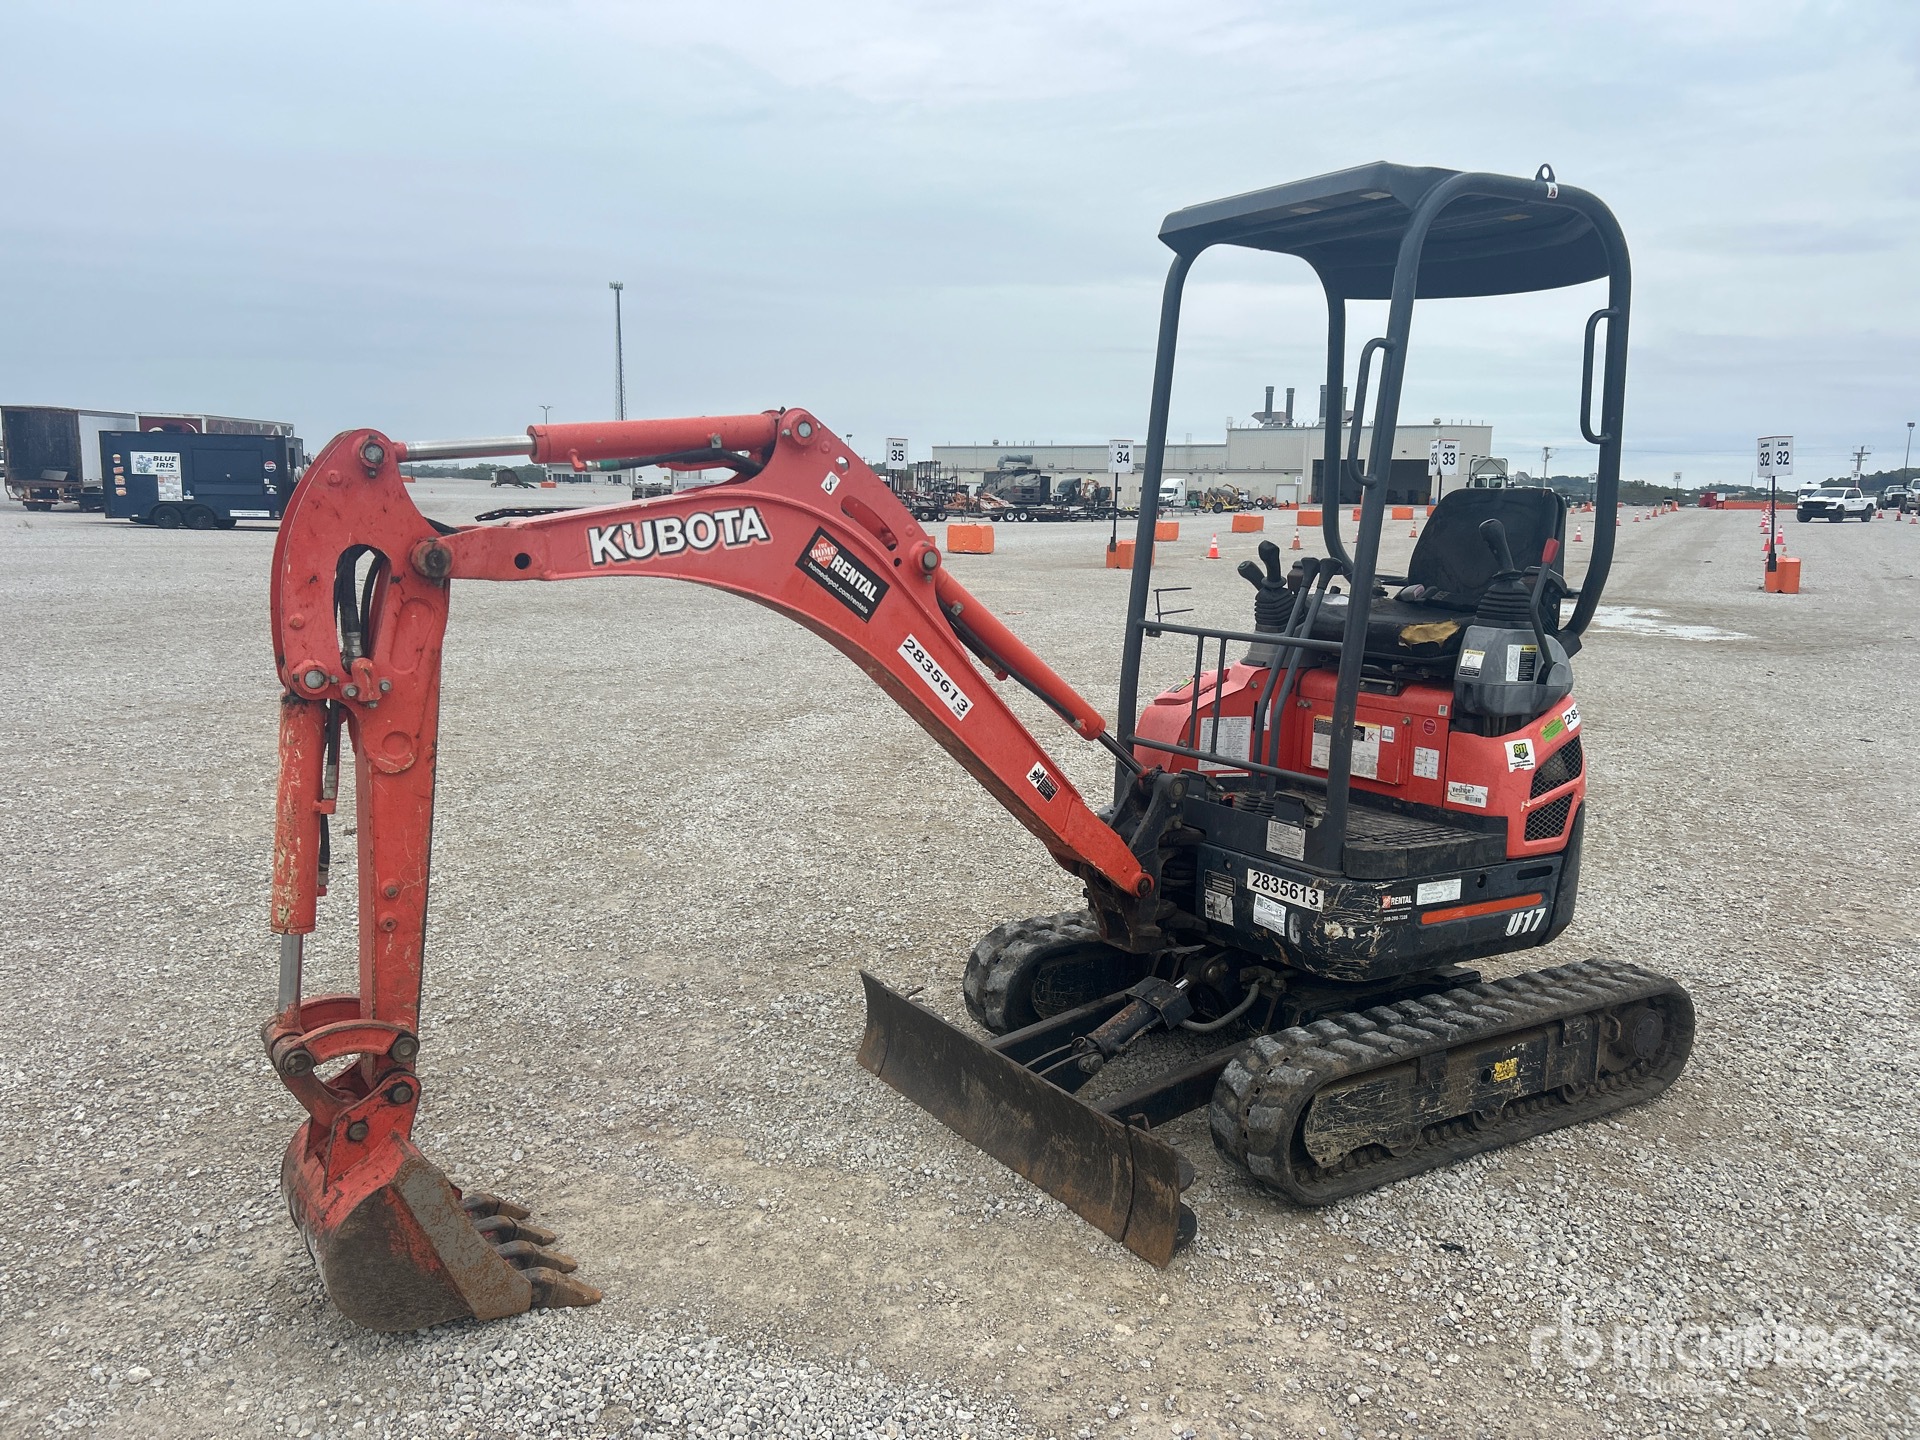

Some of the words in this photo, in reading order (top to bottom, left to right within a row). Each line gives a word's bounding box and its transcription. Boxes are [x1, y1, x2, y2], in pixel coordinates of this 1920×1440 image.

[891, 450, 904, 462] 35
[1116, 452, 1130, 464] 34
[1430, 452, 1438, 466] 33
[1442, 452, 1456, 466] 33
[1760, 452, 1770, 466] 32
[1776, 451, 1790, 466] 32
[588, 506, 769, 565] KUBOTA
[811, 546, 836, 558] HOME
[830, 554, 878, 602] RENTAL
[808, 561, 868, 614] homedepot.com/rentals
[902, 638, 968, 712] 2835613
[1514, 743, 1526, 755] 811
[1252, 872, 1318, 906] 2835613
[1391, 896, 1412, 906] RENTAL
[1505, 908, 1546, 936] U17
